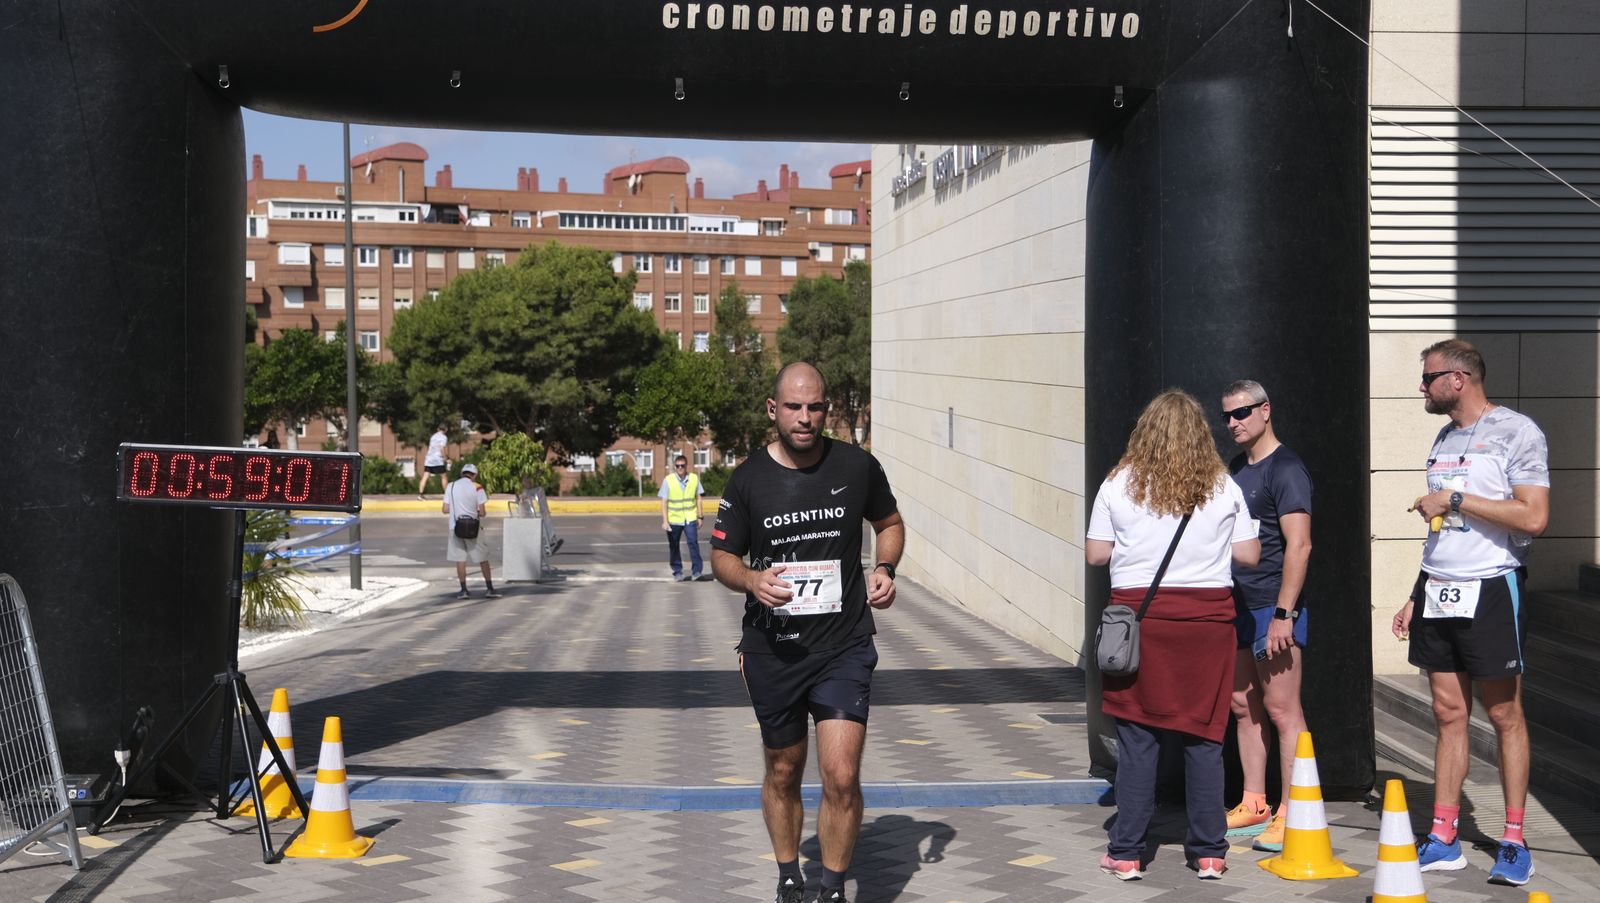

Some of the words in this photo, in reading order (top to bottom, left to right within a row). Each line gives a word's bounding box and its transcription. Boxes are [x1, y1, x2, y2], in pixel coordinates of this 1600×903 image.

[662, 2, 936, 37] cronometraje
[949, 5, 1140, 38] deportivo
[131, 452, 348, 501] 00:59:01
[764, 507, 846, 528] COSENTINO
[802, 530, 841, 540] MARATHON
[794, 579, 823, 597] 77
[1439, 587, 1461, 603] 63
